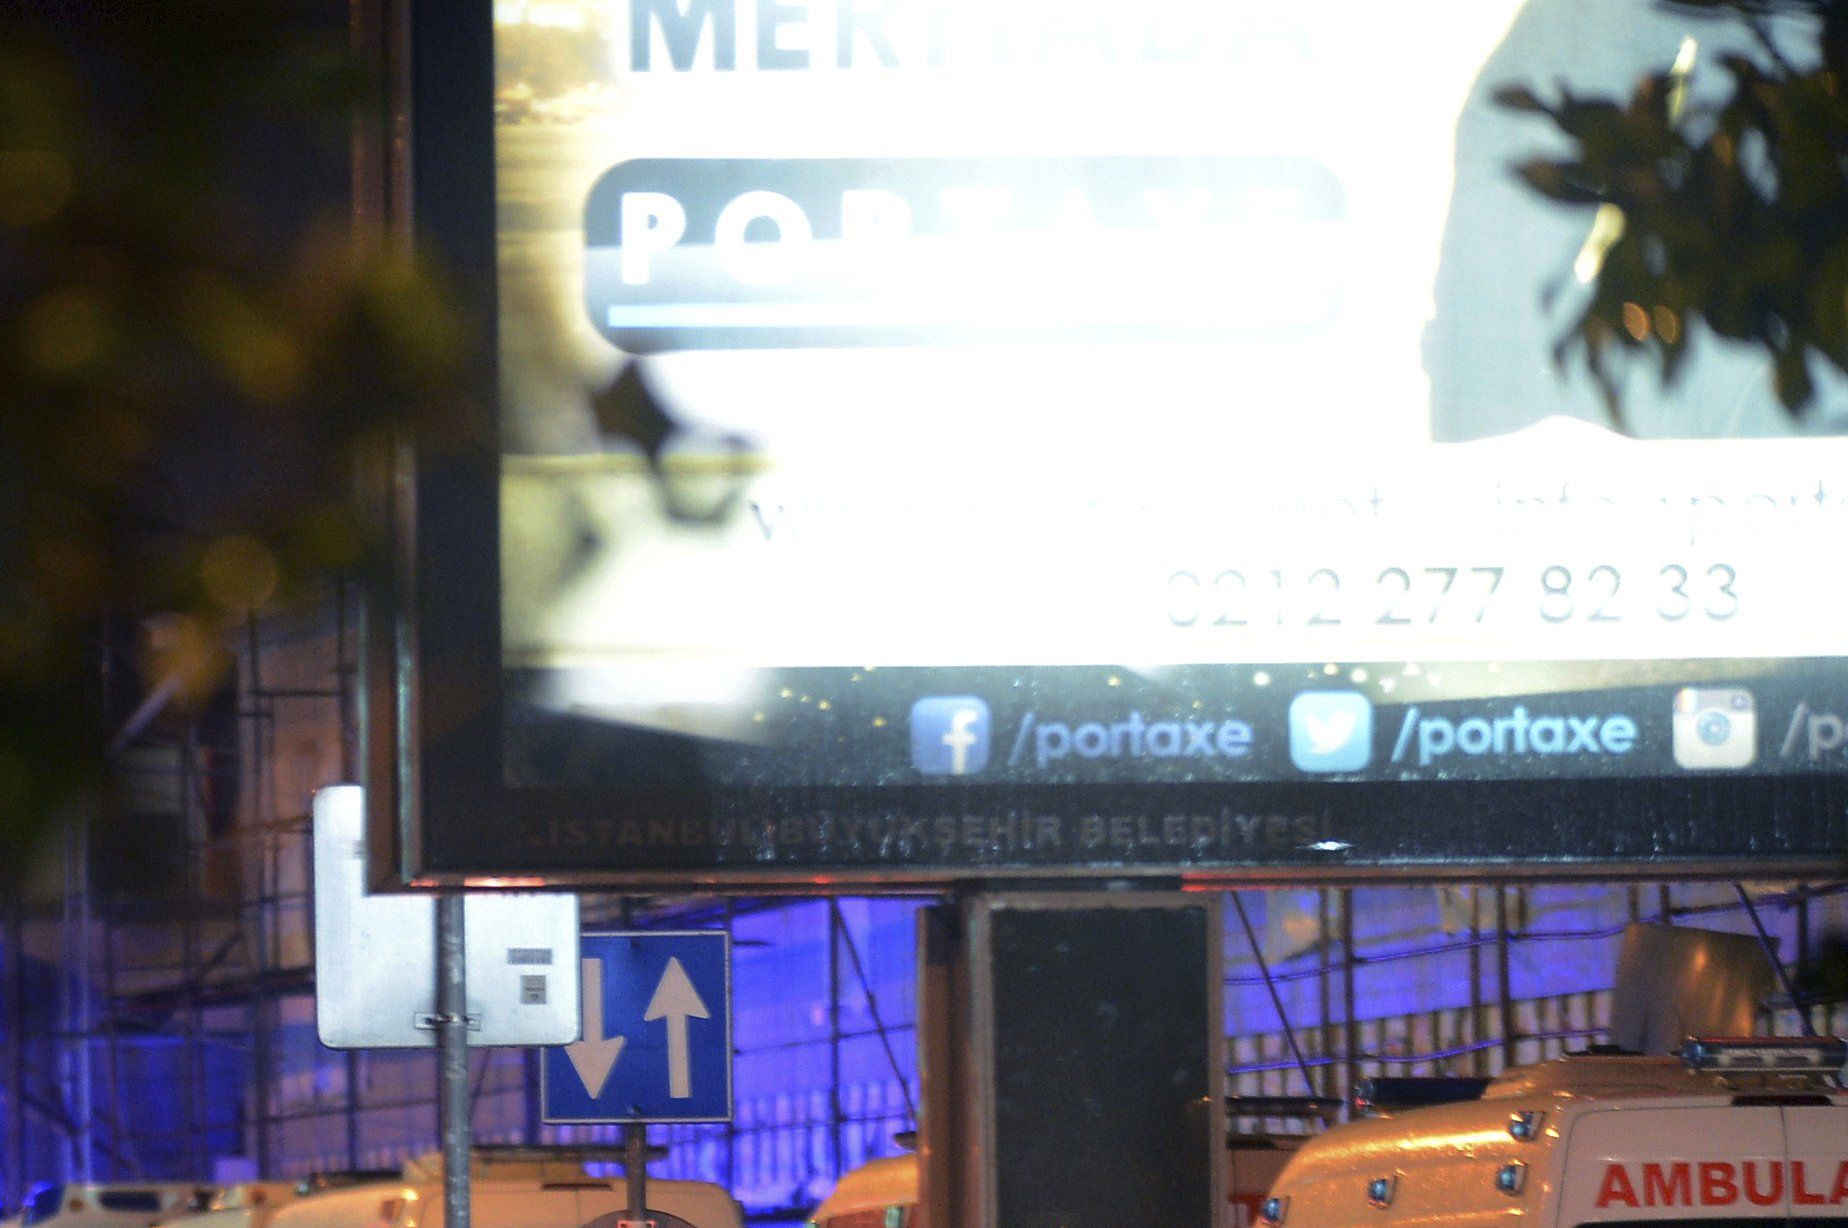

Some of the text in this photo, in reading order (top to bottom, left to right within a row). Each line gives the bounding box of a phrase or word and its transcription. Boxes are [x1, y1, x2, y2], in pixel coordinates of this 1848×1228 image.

[1376, 566, 1504, 624] 277
[1540, 565, 1621, 622] 82
[1657, 563, 1737, 621] 33
[1007, 711, 1253, 769] /portaxe
[1391, 707, 1637, 765] /portaxe
[1780, 701, 1848, 760] /p
